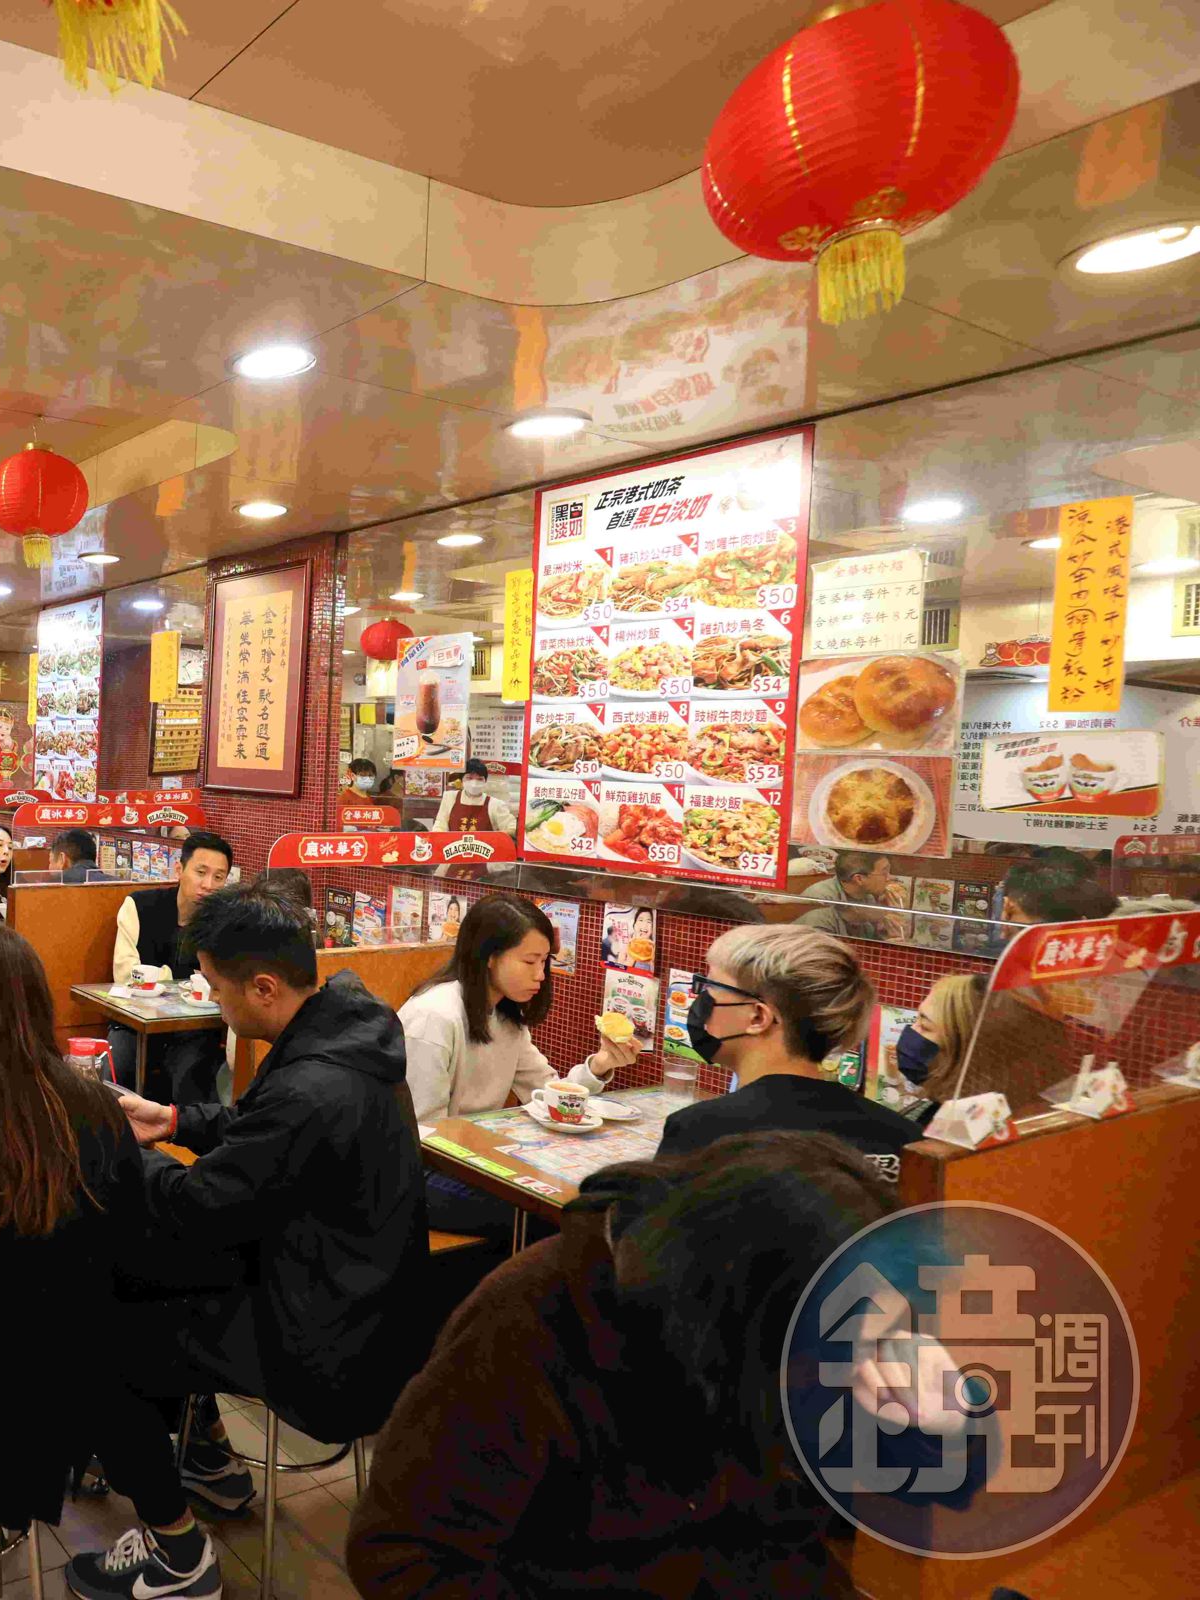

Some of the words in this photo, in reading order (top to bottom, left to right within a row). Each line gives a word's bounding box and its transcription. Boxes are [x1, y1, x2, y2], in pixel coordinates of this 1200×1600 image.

[594, 476, 685, 510] 正宗港式奶茶
[606, 493, 712, 531] 首選黑白淡奶
[787, 519, 796, 533] 3
[689, 535, 697, 548] 2
[604, 550, 611, 561] 1
[543, 560, 583, 577] 星洲炒米
[758, 588, 794, 604] $50
[583, 604, 612, 621] $50
[664, 600, 689, 613] $54
[780, 611, 791, 624] 6
[684, 619, 693, 632] 5
[599, 628, 608, 640] 4
[579, 681, 608, 698] $50
[660, 678, 691, 696] $50
[753, 677, 782, 693] $54
[596, 705, 605, 717] 7
[679, 703, 688, 716] 8
[775, 701, 786, 715] 9
[535, 711, 575, 724] 乾炒牛河
[612, 711, 670, 724] 西式炒通粉
[574, 763, 598, 774] $50
[655, 763, 684, 778] $50
[748, 766, 777, 782] $52
[591, 783, 600, 795] 10
[674, 787, 684, 798] 11
[605, 790, 662, 805] 鮮茄雞扒飯
[689, 795, 742, 809] 福建炒飯
[769, 792, 781, 805] 12
[571, 838, 593, 850] $42
[649, 845, 675, 861] $56
[741, 855, 772, 872] $57
